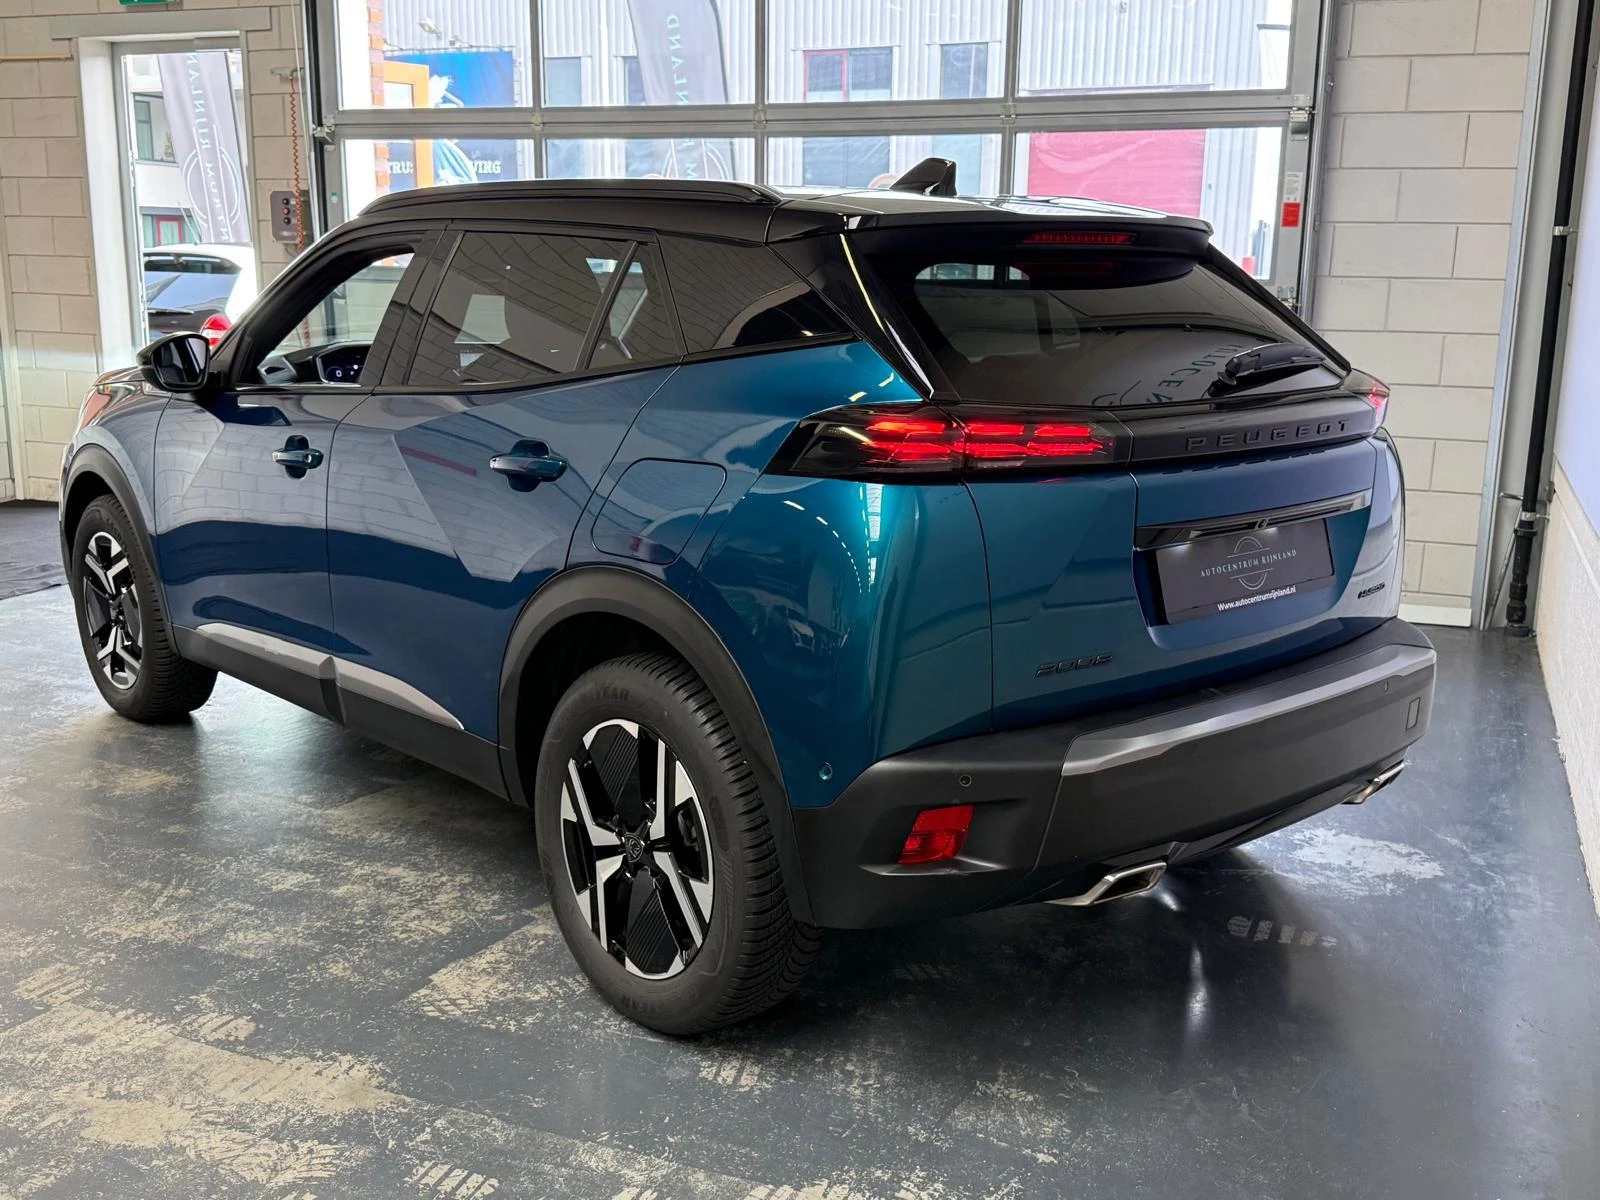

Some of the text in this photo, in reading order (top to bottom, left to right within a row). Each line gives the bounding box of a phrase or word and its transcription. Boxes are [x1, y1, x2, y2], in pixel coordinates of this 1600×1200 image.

[1185, 419, 1352, 451] PEUGEOT
[1199, 549, 1297, 577] AUTOCENTRUM RIJNLAND
